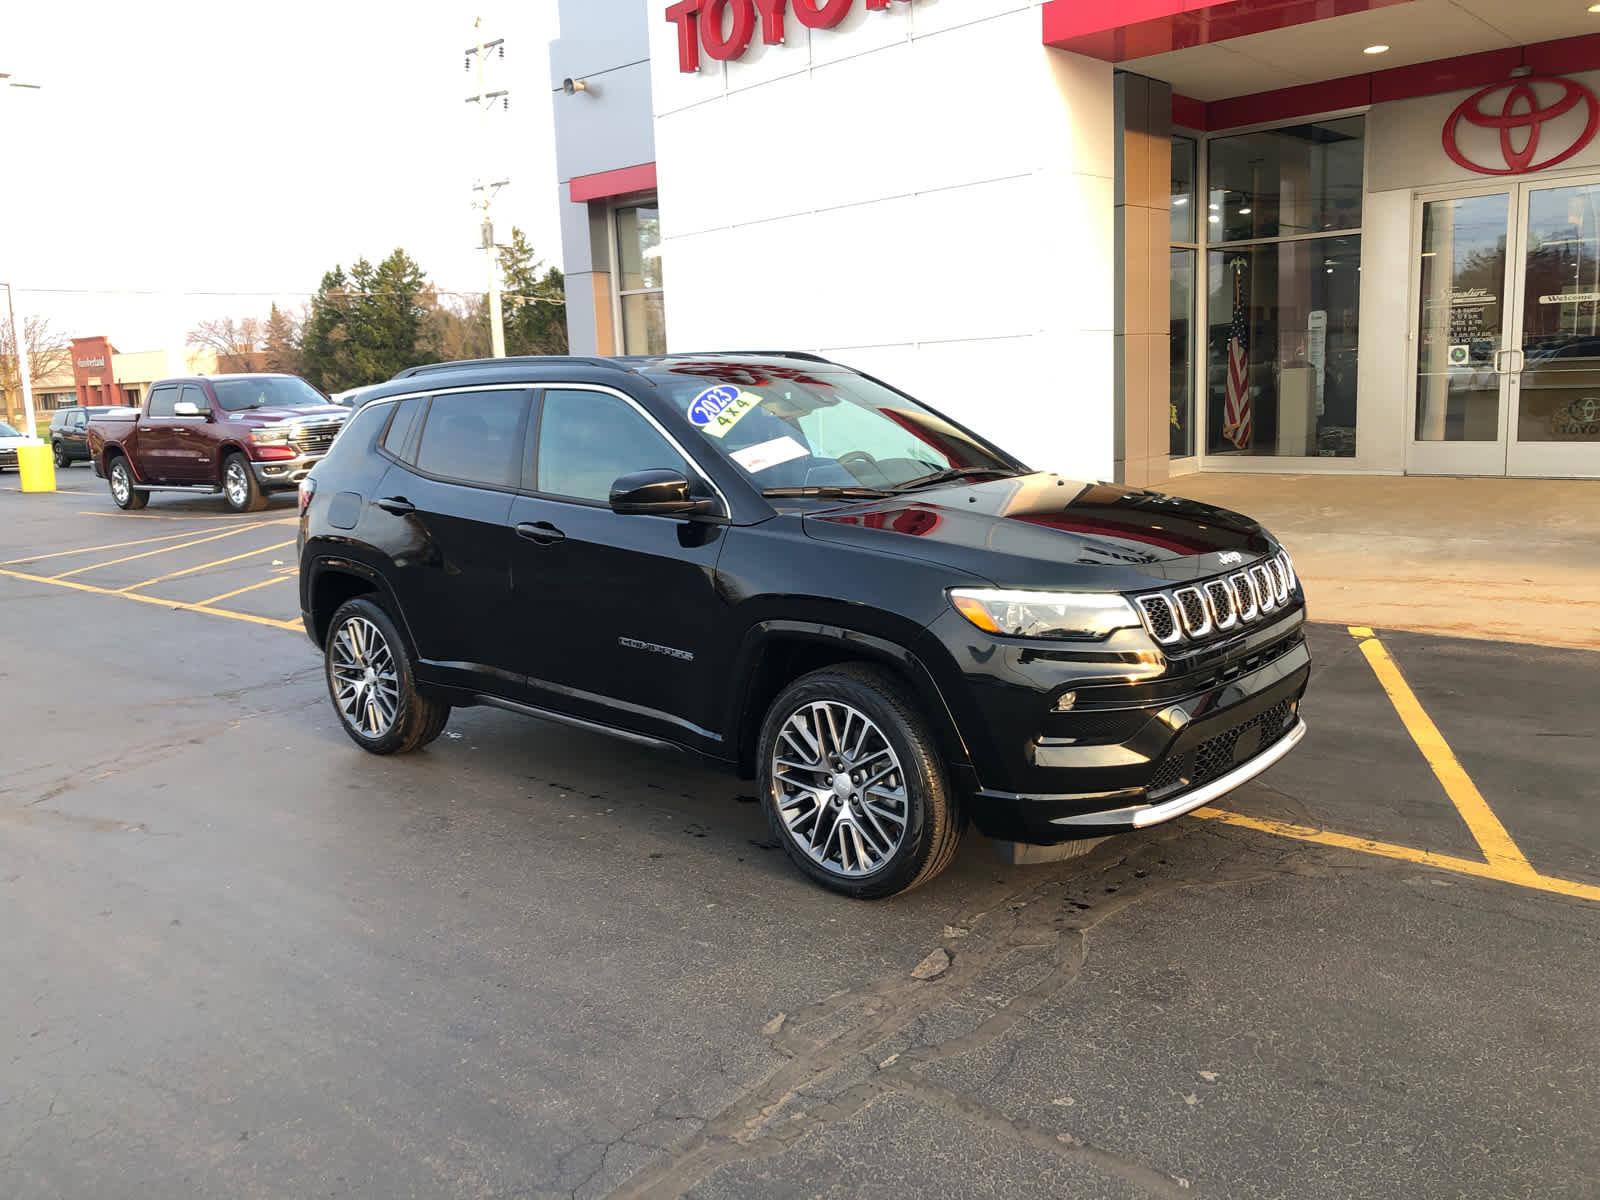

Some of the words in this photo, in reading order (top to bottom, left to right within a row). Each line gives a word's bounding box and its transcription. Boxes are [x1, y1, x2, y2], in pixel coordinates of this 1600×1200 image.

[665, 0, 912, 73] TOY
[694, 388, 733, 421] 2023
[1218, 551, 1242, 565] Jeep
